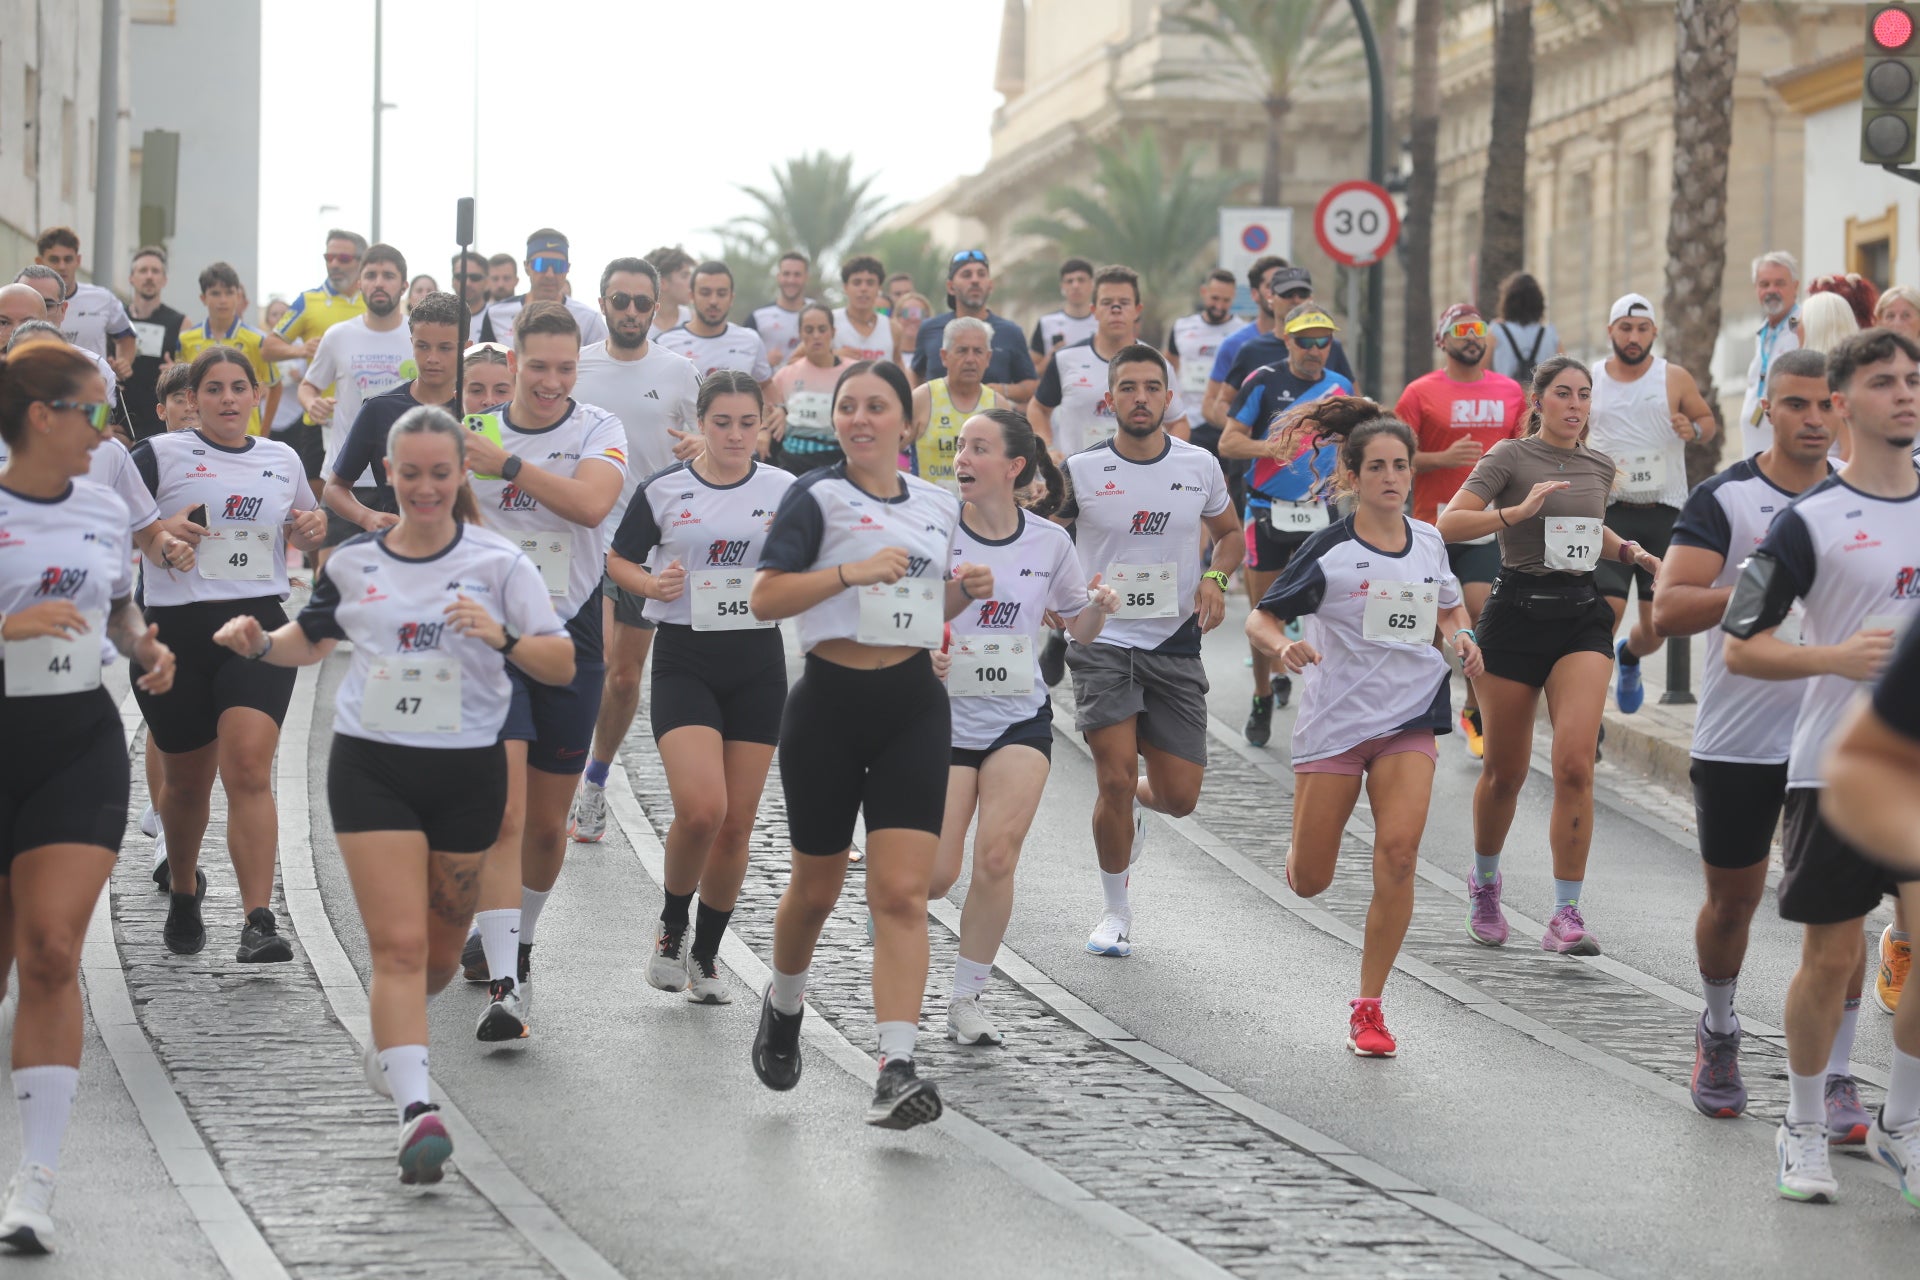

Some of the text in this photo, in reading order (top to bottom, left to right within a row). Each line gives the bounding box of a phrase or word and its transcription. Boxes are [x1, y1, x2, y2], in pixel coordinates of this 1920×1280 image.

[1334, 209, 1379, 236] 30
[1451, 399, 1504, 423] RUN
[1630, 471, 1652, 483] 385
[1094, 489, 1126, 497] Santander
[672, 517, 702, 528] Santander
[1290, 513, 1311, 524] 105
[228, 552, 249, 567] 49
[1566, 544, 1590, 559] 217
[717, 600, 749, 616] 545
[1126, 593, 1155, 607] 365
[892, 612, 913, 629] 17
[1388, 613, 1417, 629] 625
[48, 655, 73, 674] 44
[975, 666, 1008, 682] 100
[395, 697, 422, 715] 47
